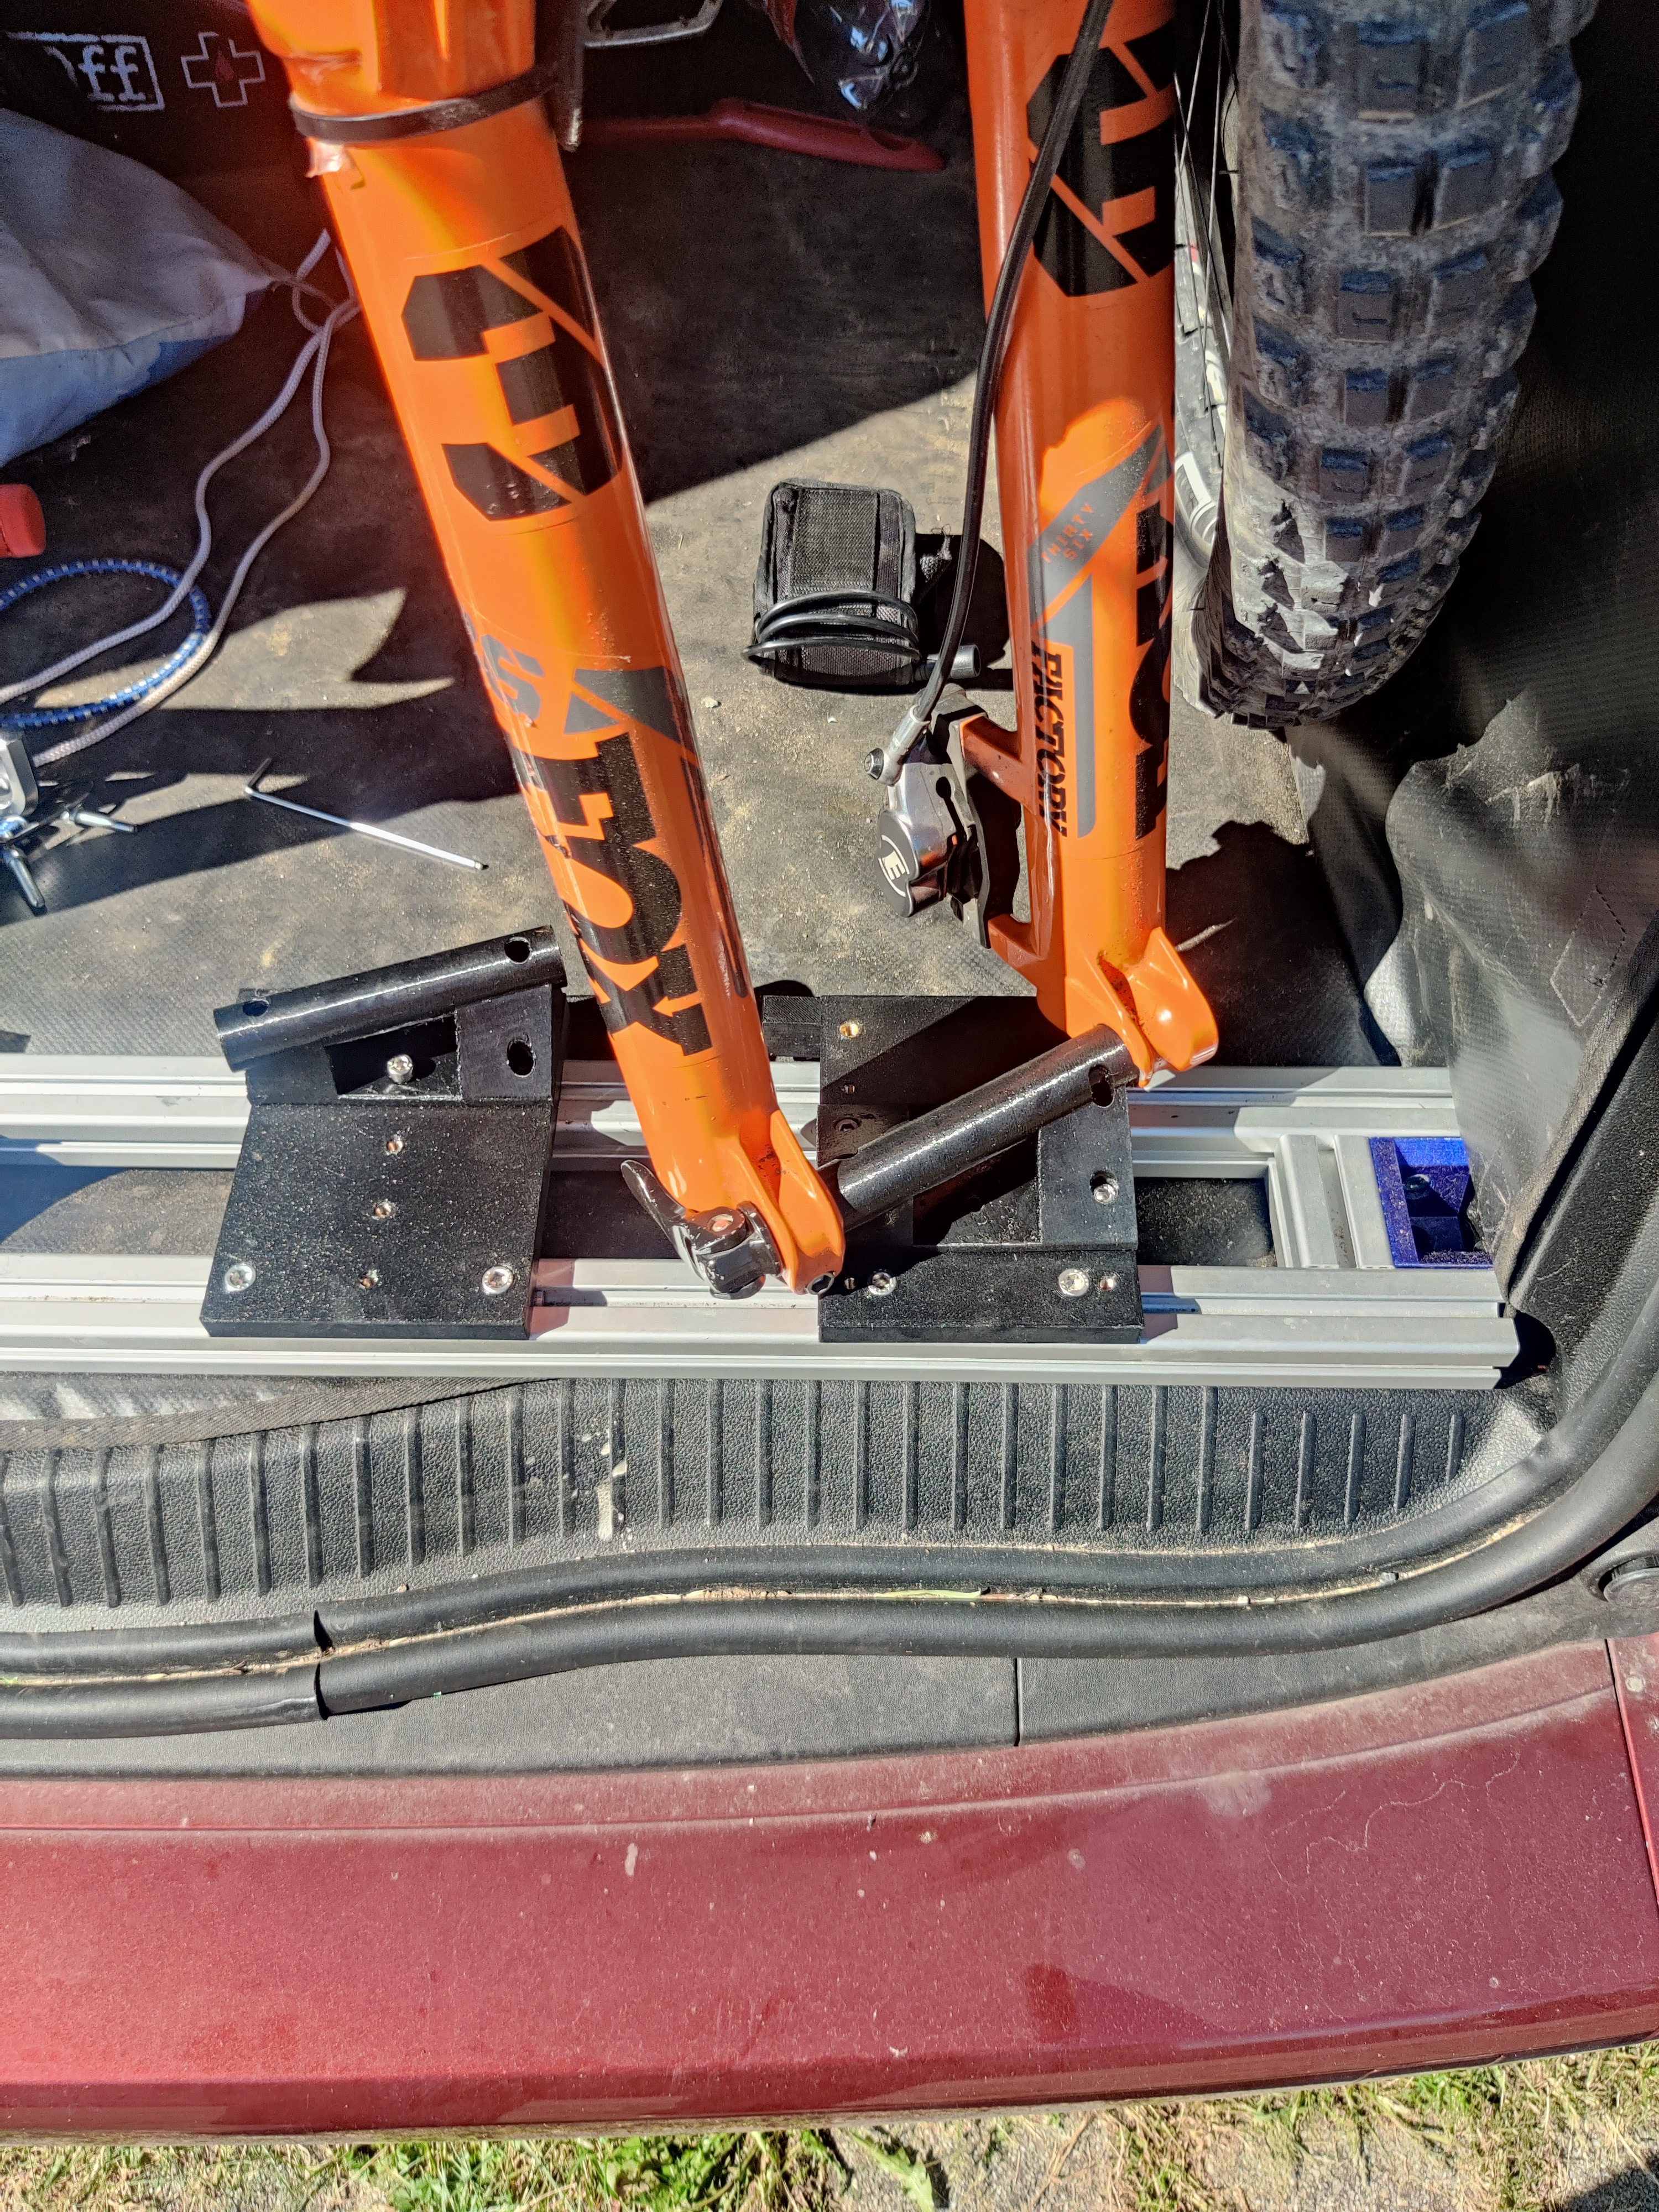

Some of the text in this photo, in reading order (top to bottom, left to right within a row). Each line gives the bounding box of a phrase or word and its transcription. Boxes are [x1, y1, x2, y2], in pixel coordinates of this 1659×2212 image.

[1041, 502, 1094, 563] THIRTY
[1063, 528, 1093, 560] SIX
[1031, 639, 1068, 837] FACTORY
[507, 732, 713, 1057] FOX
